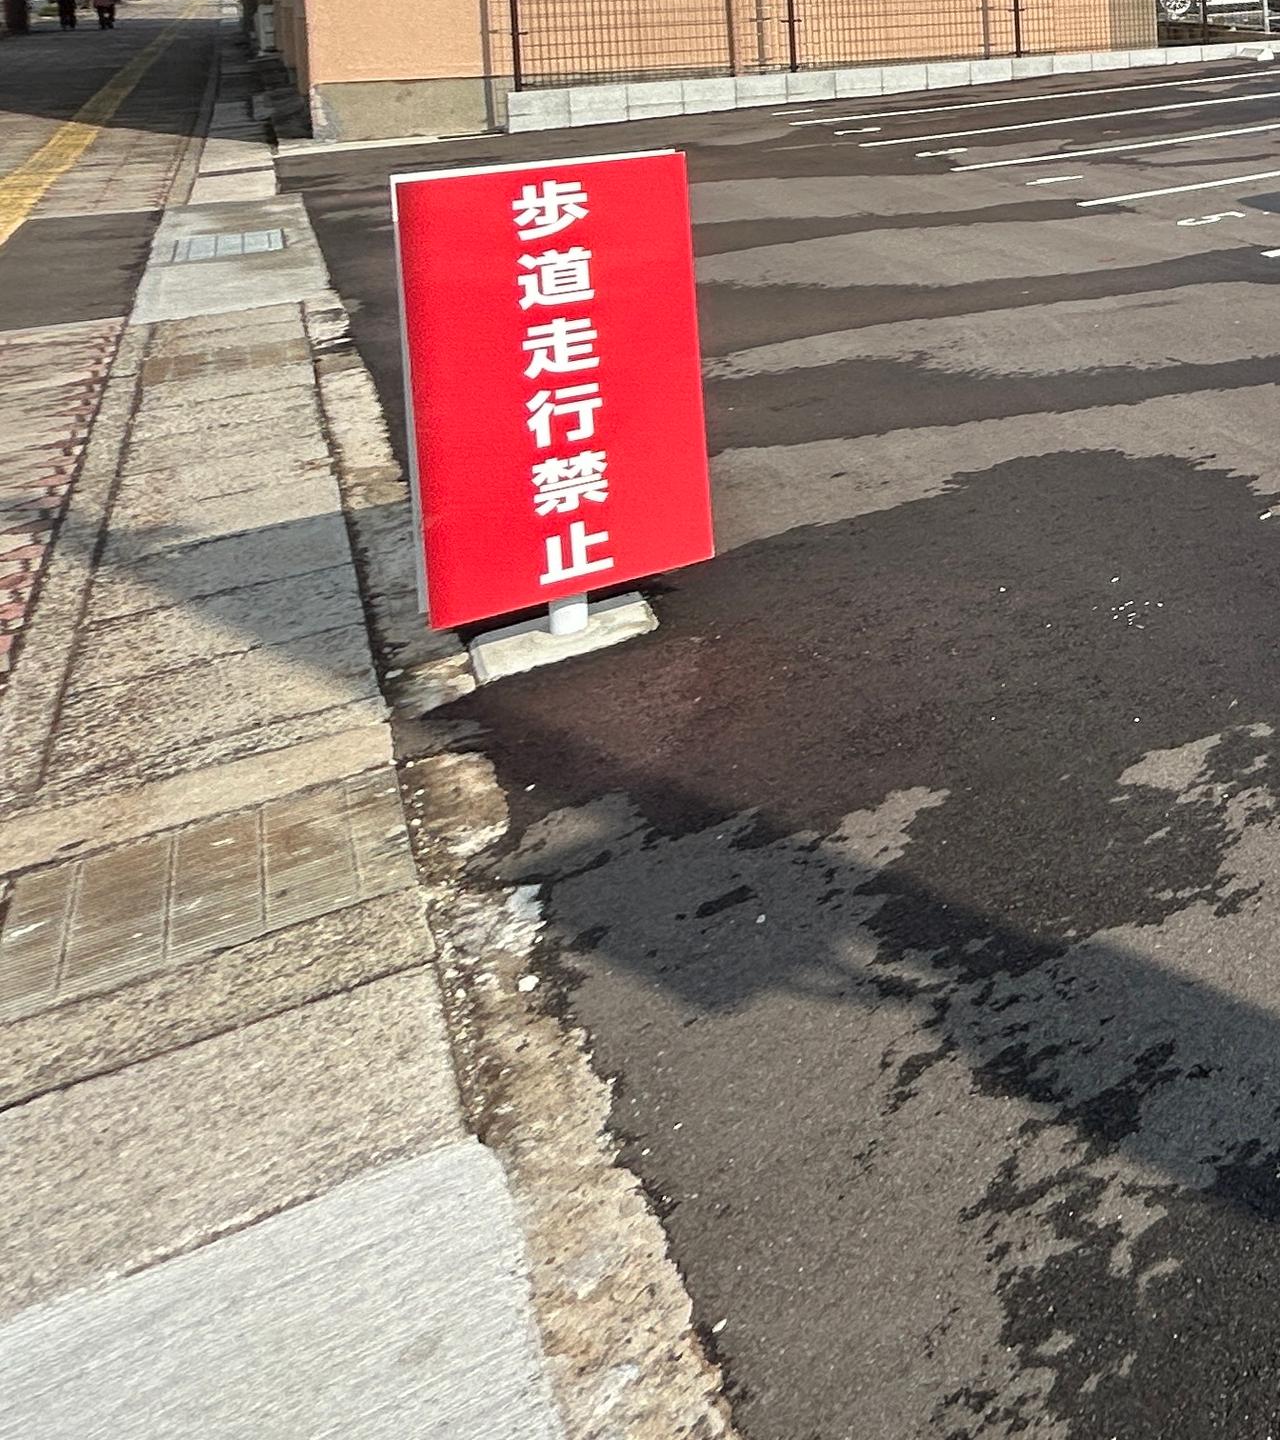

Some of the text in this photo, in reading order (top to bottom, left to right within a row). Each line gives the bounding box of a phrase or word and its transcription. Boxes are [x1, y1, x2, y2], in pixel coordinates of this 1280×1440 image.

[511, 179, 615, 586] 歩道走行禁止
